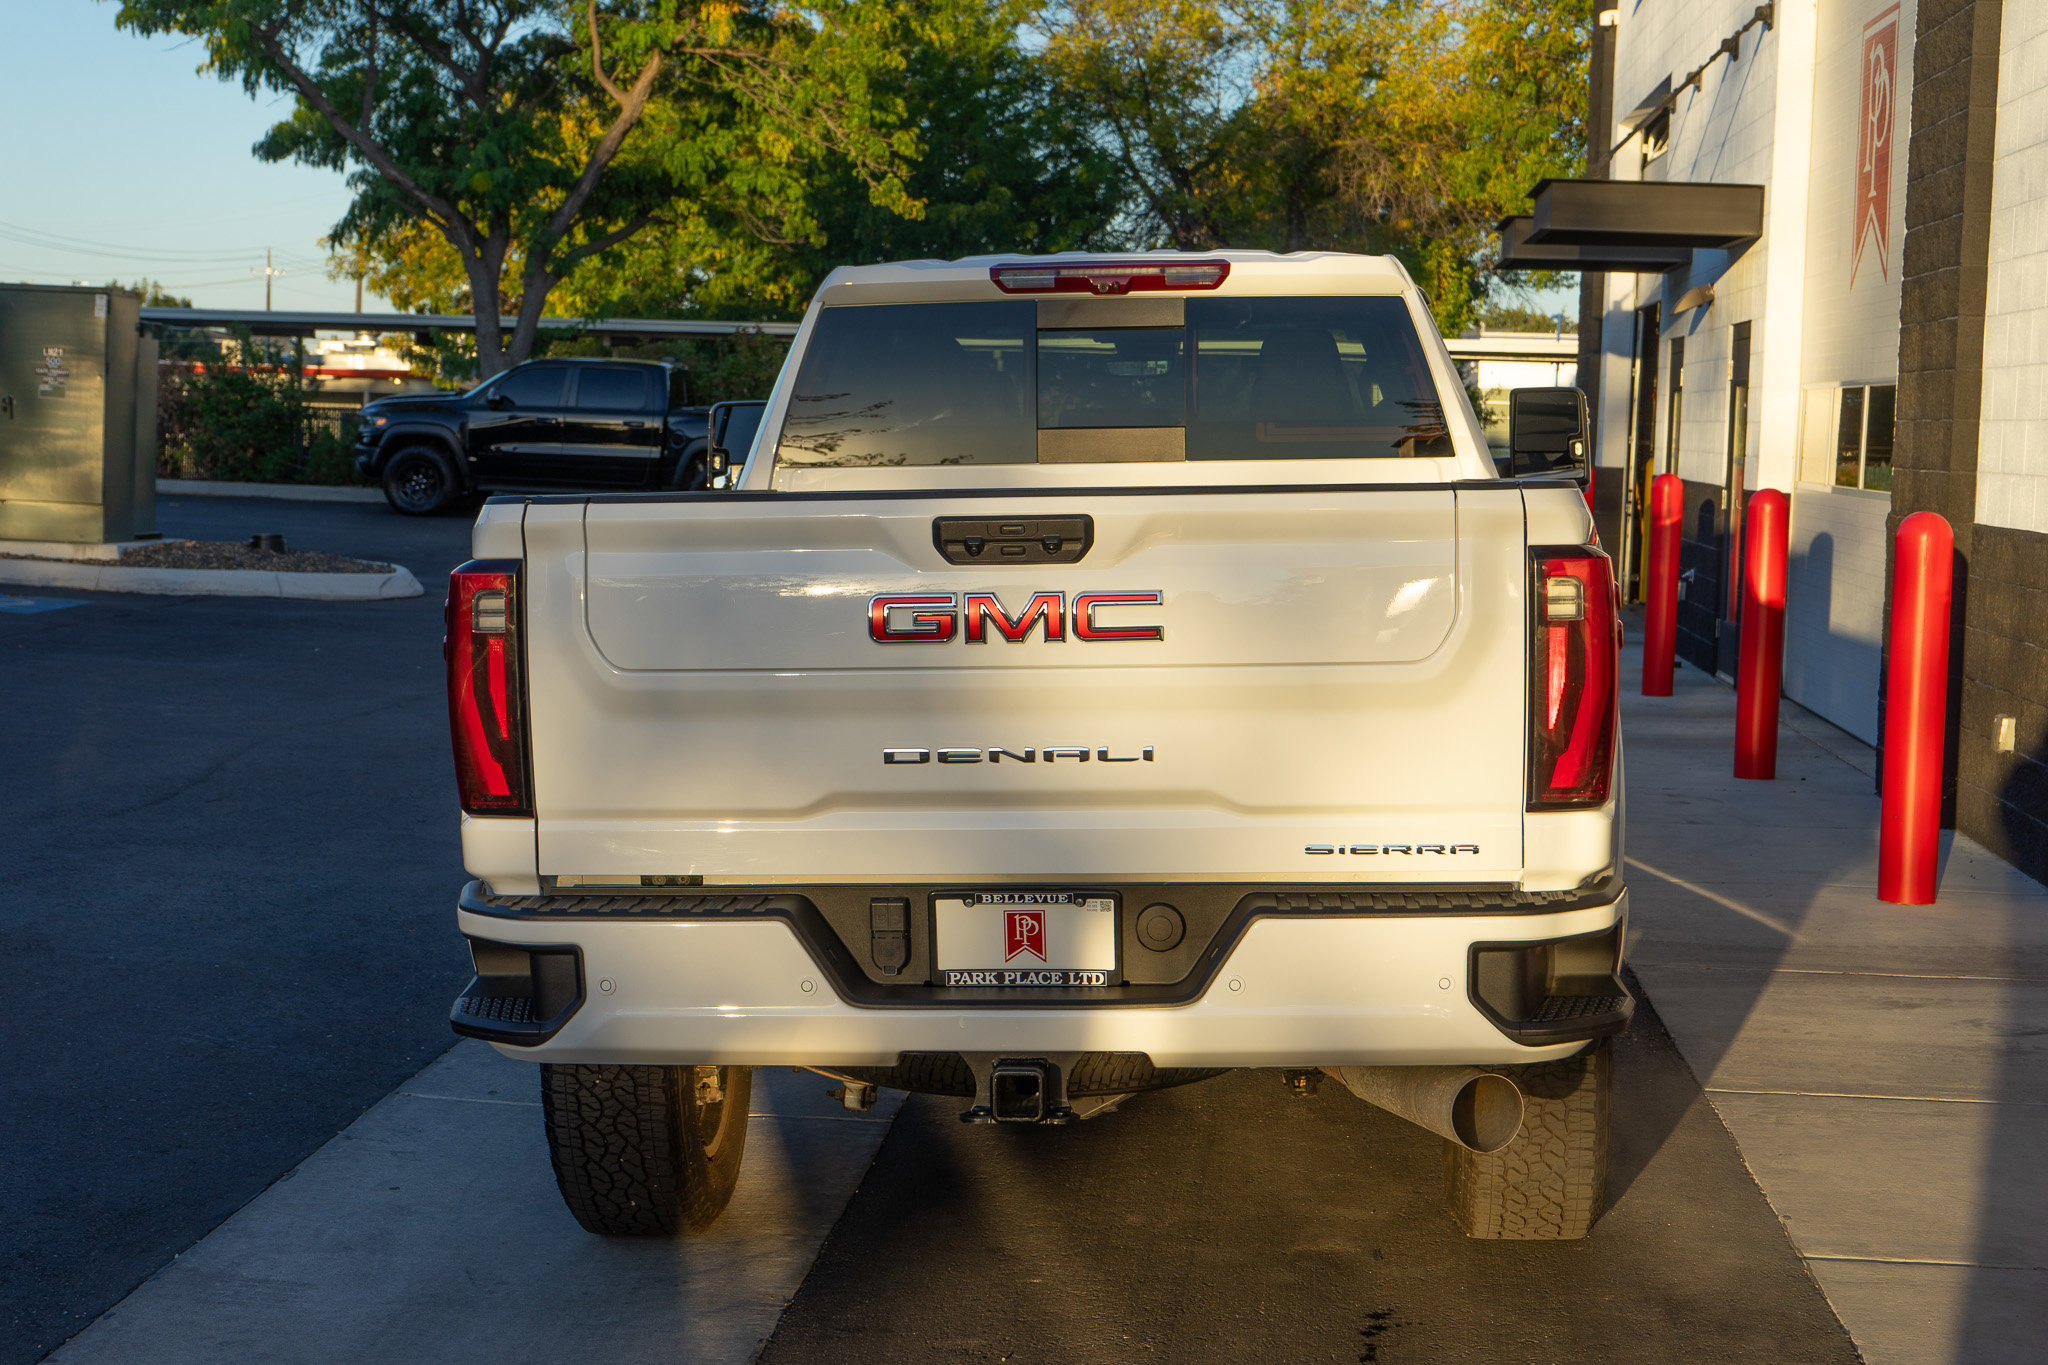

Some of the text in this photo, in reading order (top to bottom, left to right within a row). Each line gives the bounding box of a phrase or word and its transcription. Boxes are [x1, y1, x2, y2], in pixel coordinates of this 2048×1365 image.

[867, 590, 1164, 644] GMC
[883, 746, 1154, 764] DENALI
[1304, 844, 1480, 855] SIERRA
[981, 894, 1069, 904] BELLEVUE
[949, 972, 1105, 985] PARK PLACE LTD
